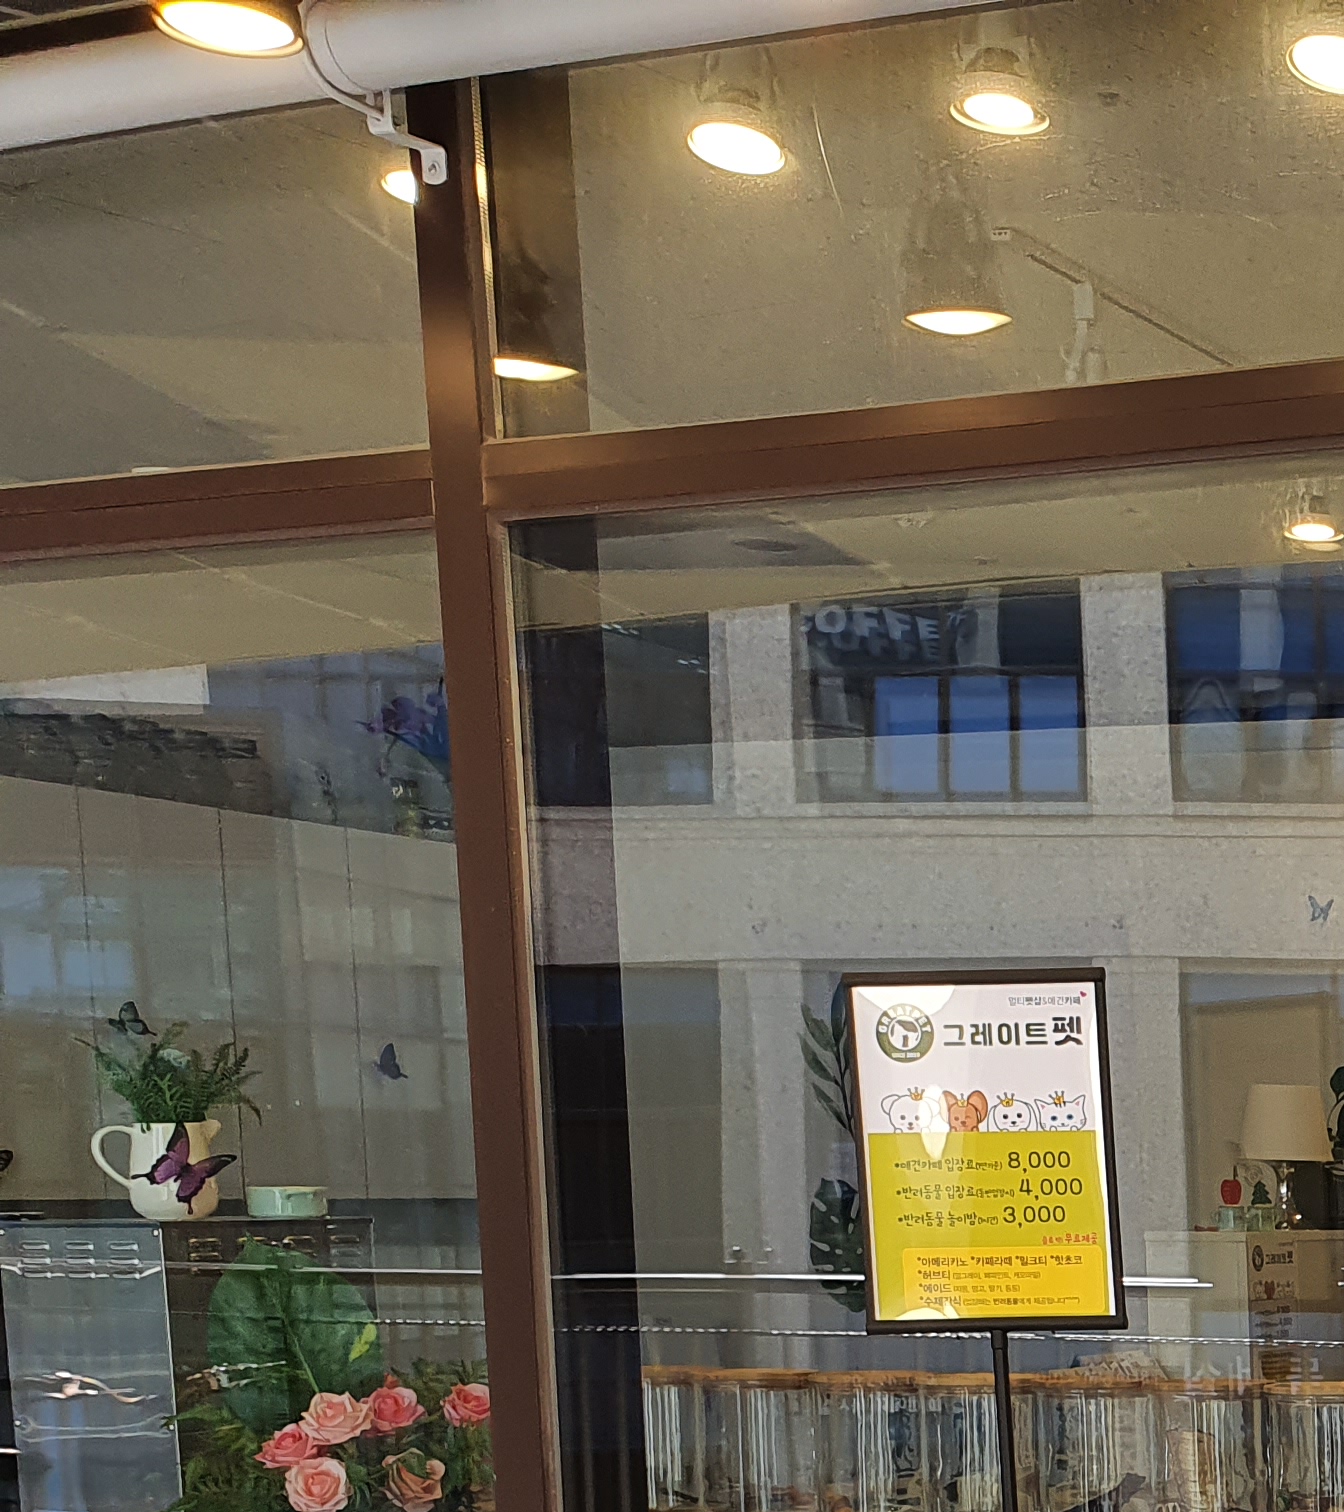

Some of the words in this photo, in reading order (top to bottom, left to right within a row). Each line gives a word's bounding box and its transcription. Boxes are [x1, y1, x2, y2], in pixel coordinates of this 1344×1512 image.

[943, 1016, 1083, 1046] 그레이트펫
[1008, 1151, 1071, 1173] 8,000
[902, 1184, 944, 1200] 반려동물
[1019, 1178, 1083, 1200] 4,000
[904, 1211, 945, 1227] 반려동물
[1003, 1205, 1066, 1228] 3,000
